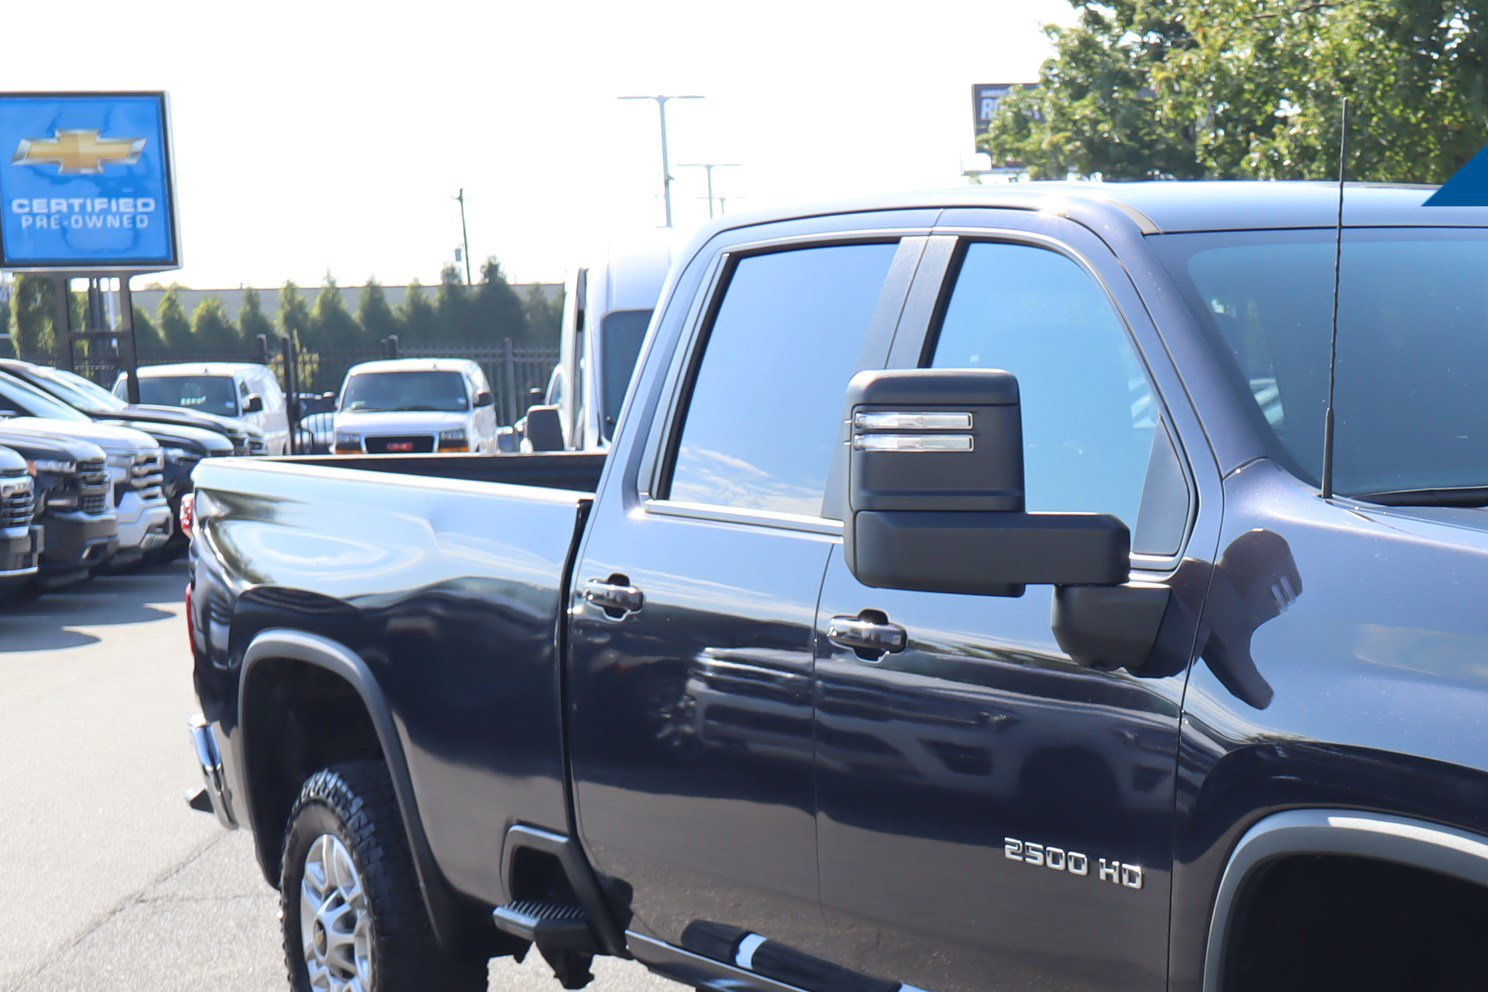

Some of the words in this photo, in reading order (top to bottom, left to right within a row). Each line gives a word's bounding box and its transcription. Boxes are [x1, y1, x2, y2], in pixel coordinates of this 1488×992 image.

[11, 197, 156, 214] CERTIFIED
[21, 214, 149, 230] PRE-OWNED
[1004, 837, 1089, 876] 2500
[1098, 857, 1143, 890] HD
